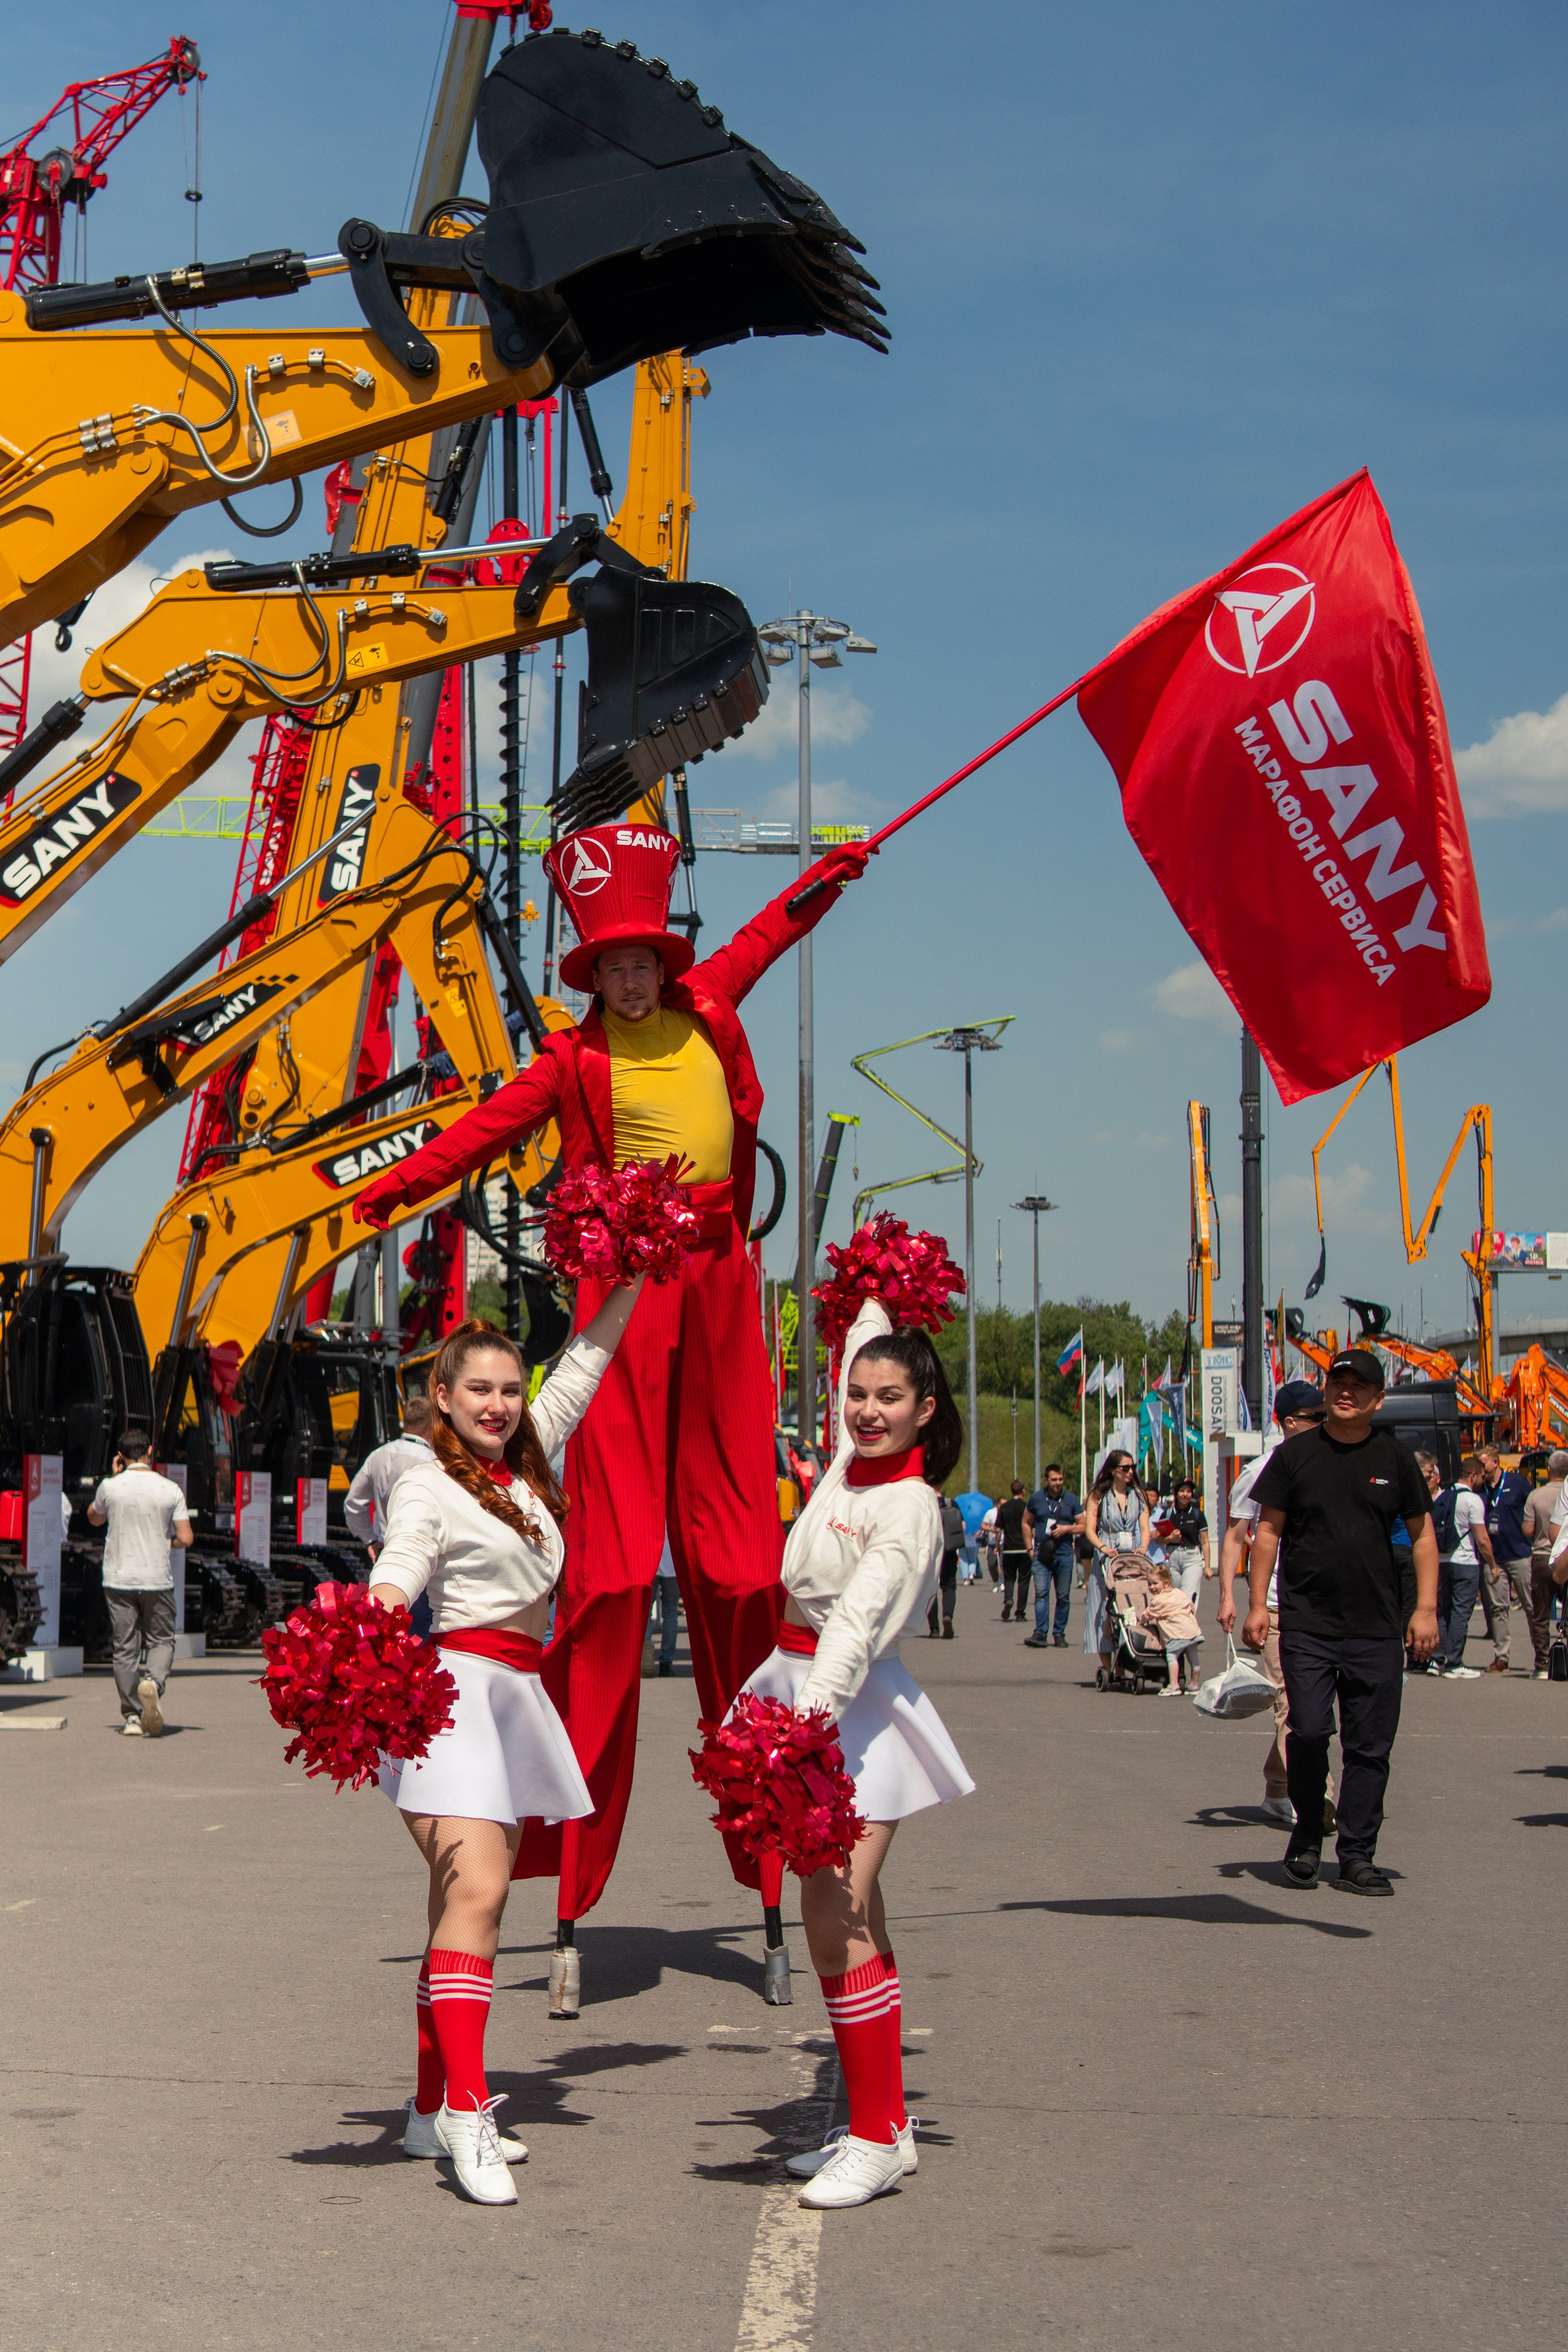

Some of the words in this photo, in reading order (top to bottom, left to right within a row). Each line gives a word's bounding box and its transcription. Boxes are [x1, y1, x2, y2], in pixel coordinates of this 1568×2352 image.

[2, 780, 115, 899] SANY
[616, 830, 671, 852] SANY
[1234, 715, 1327, 862] МАРАФОН
[1312, 859, 1396, 987] СЕРВИСА
[1267, 680, 1447, 952] SANY
[194, 984, 257, 1042] SANY
[334, 1121, 425, 1186] SANY
